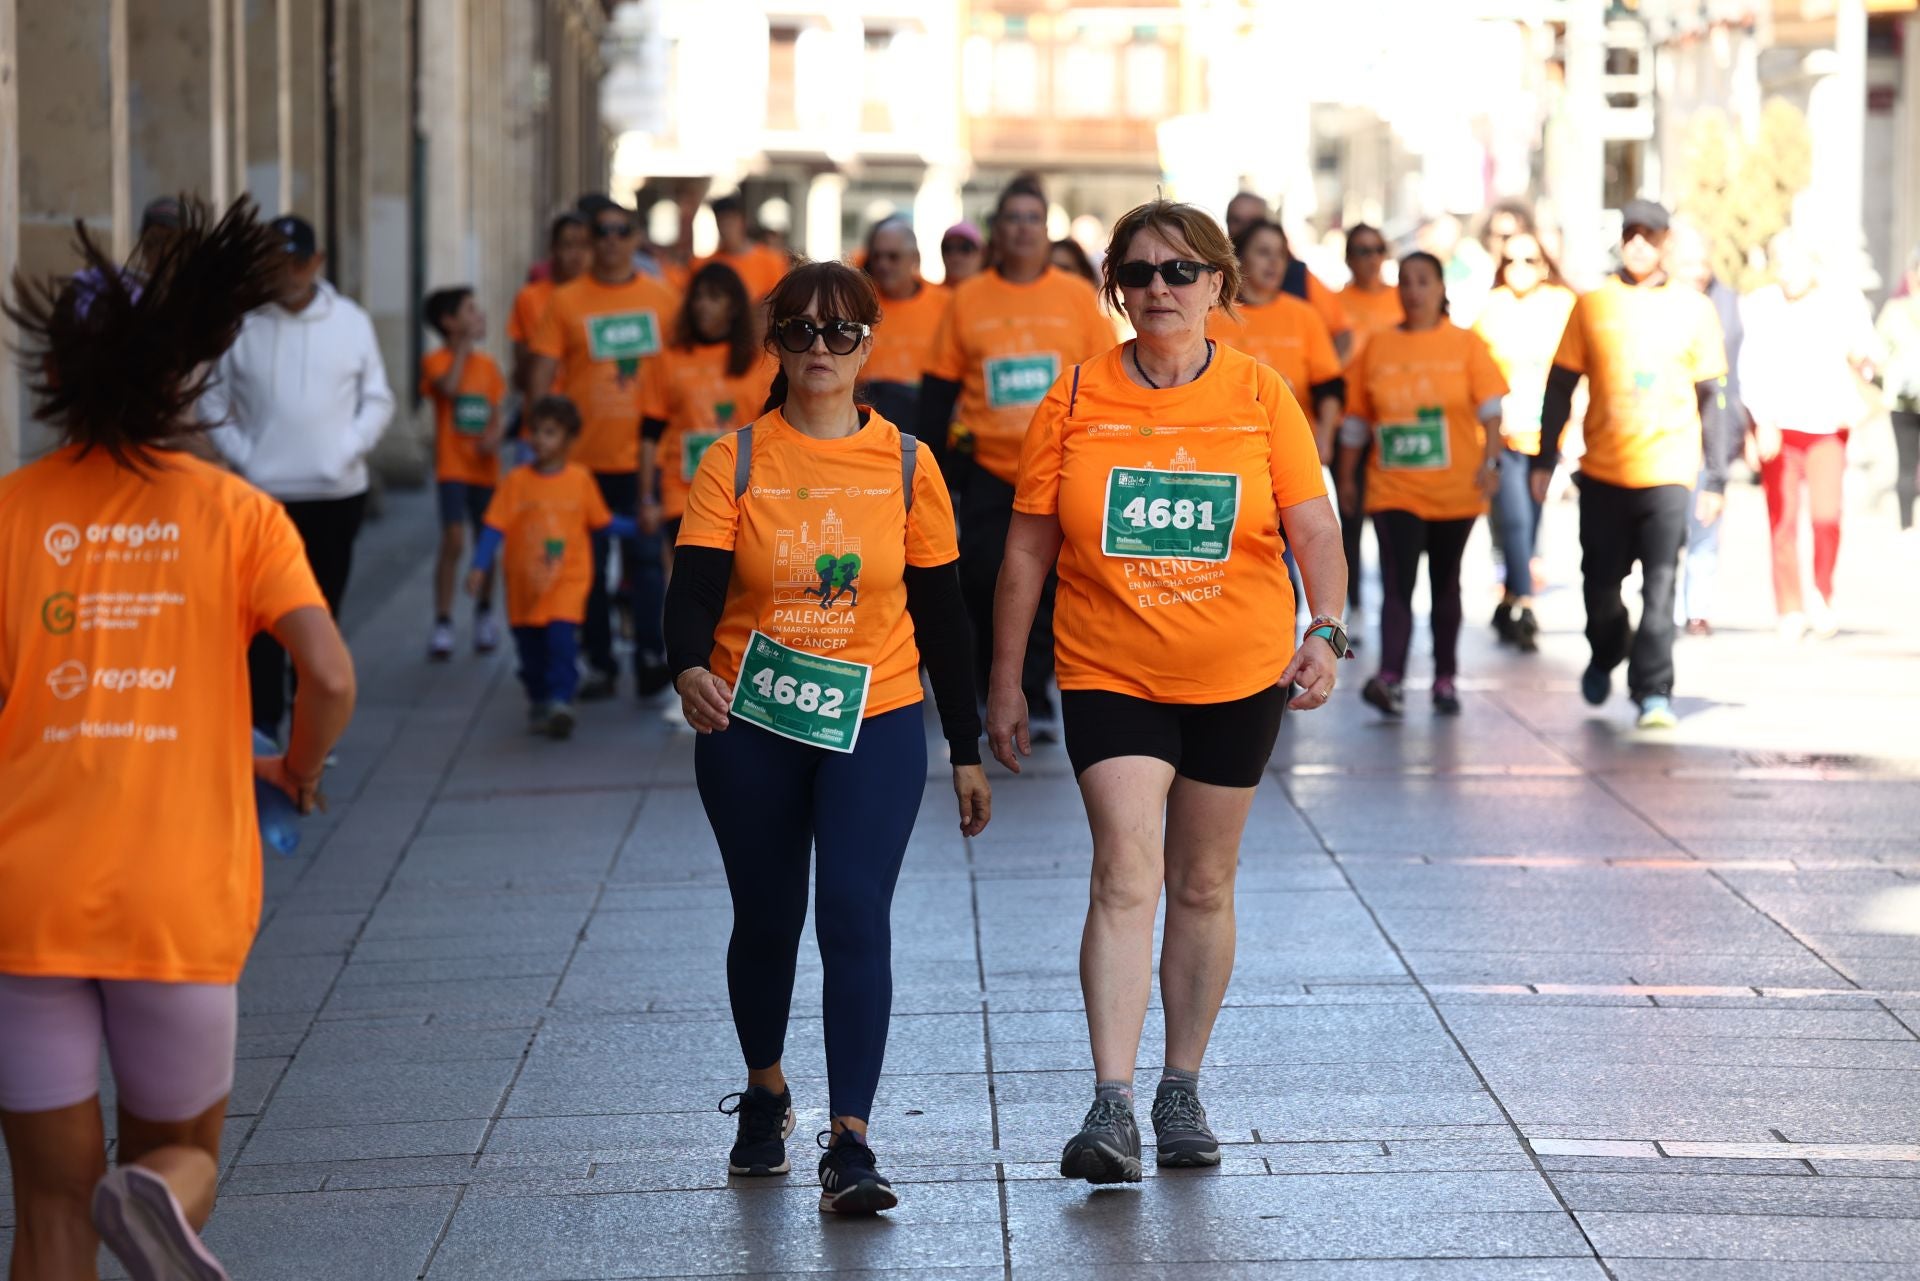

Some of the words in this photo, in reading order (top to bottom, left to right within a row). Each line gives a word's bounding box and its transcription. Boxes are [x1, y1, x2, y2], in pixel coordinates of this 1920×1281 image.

[863, 488, 891, 496] repsol
[1123, 497, 1215, 531] 4681
[86, 519, 180, 547] oregón
[1128, 581, 1141, 590] EN
[1186, 569, 1225, 585] CONTRA
[1138, 595, 1155, 608] EL
[773, 610, 856, 625] PALENCIA
[773, 625, 782, 633] EN
[783, 626, 819, 634] MARCHA
[792, 635, 847, 649] CÁNCER
[92, 666, 176, 693] repsol
[753, 667, 844, 719] 4682
[144, 725, 178, 742] gas
